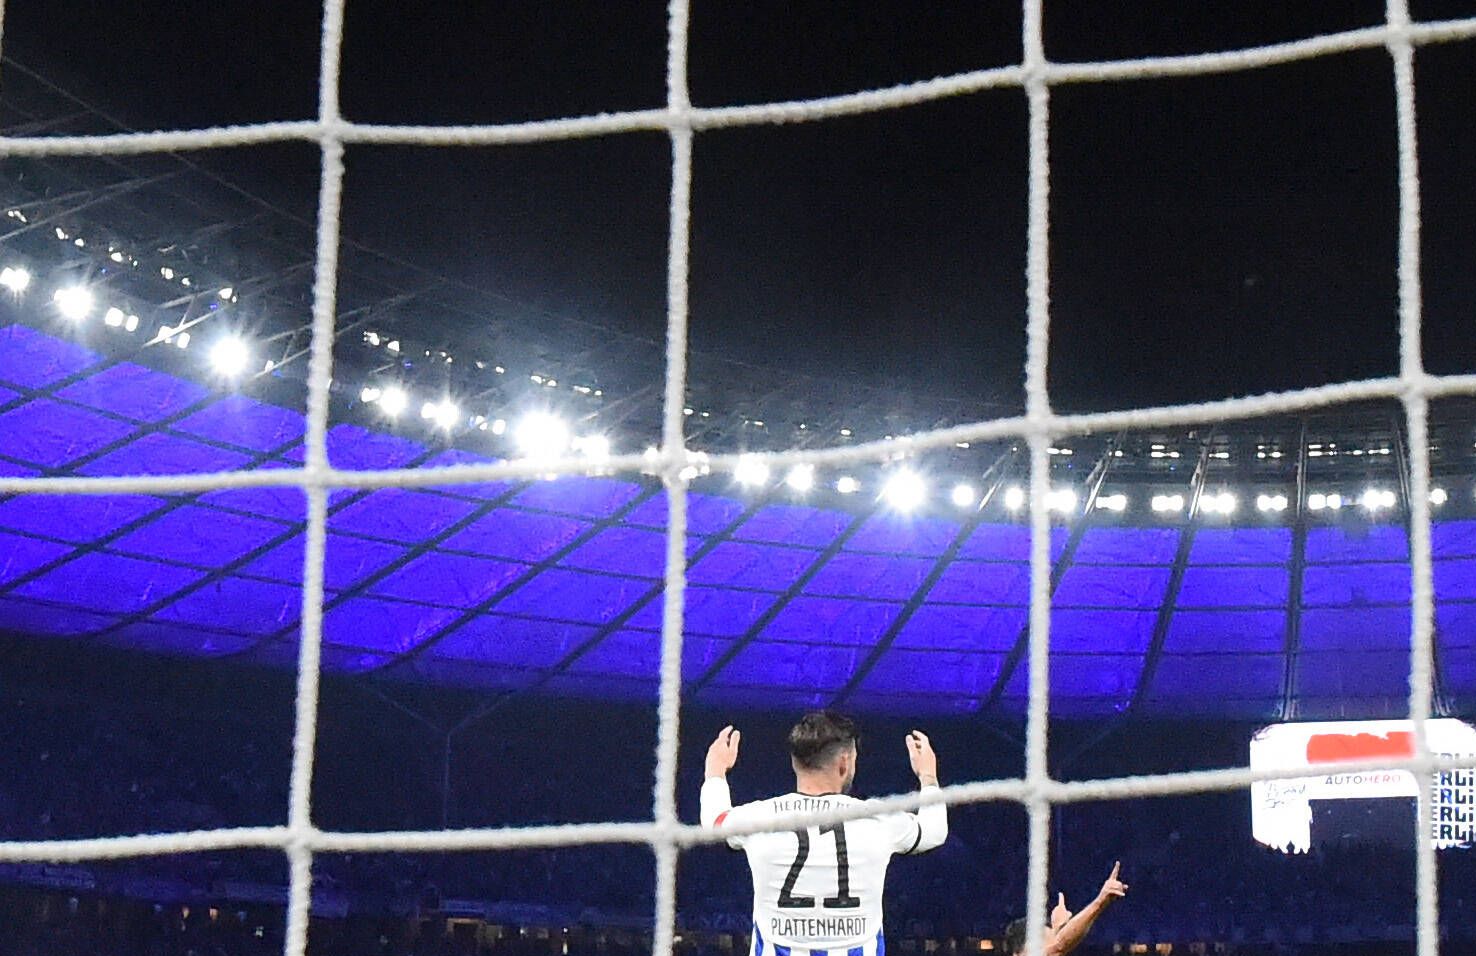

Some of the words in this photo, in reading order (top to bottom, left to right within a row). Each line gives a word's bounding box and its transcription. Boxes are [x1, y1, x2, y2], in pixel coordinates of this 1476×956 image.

[1324, 773, 1402, 786] AUTOHERO
[777, 822, 861, 909] 21
[771, 916, 867, 937] PLATTENHARDT
